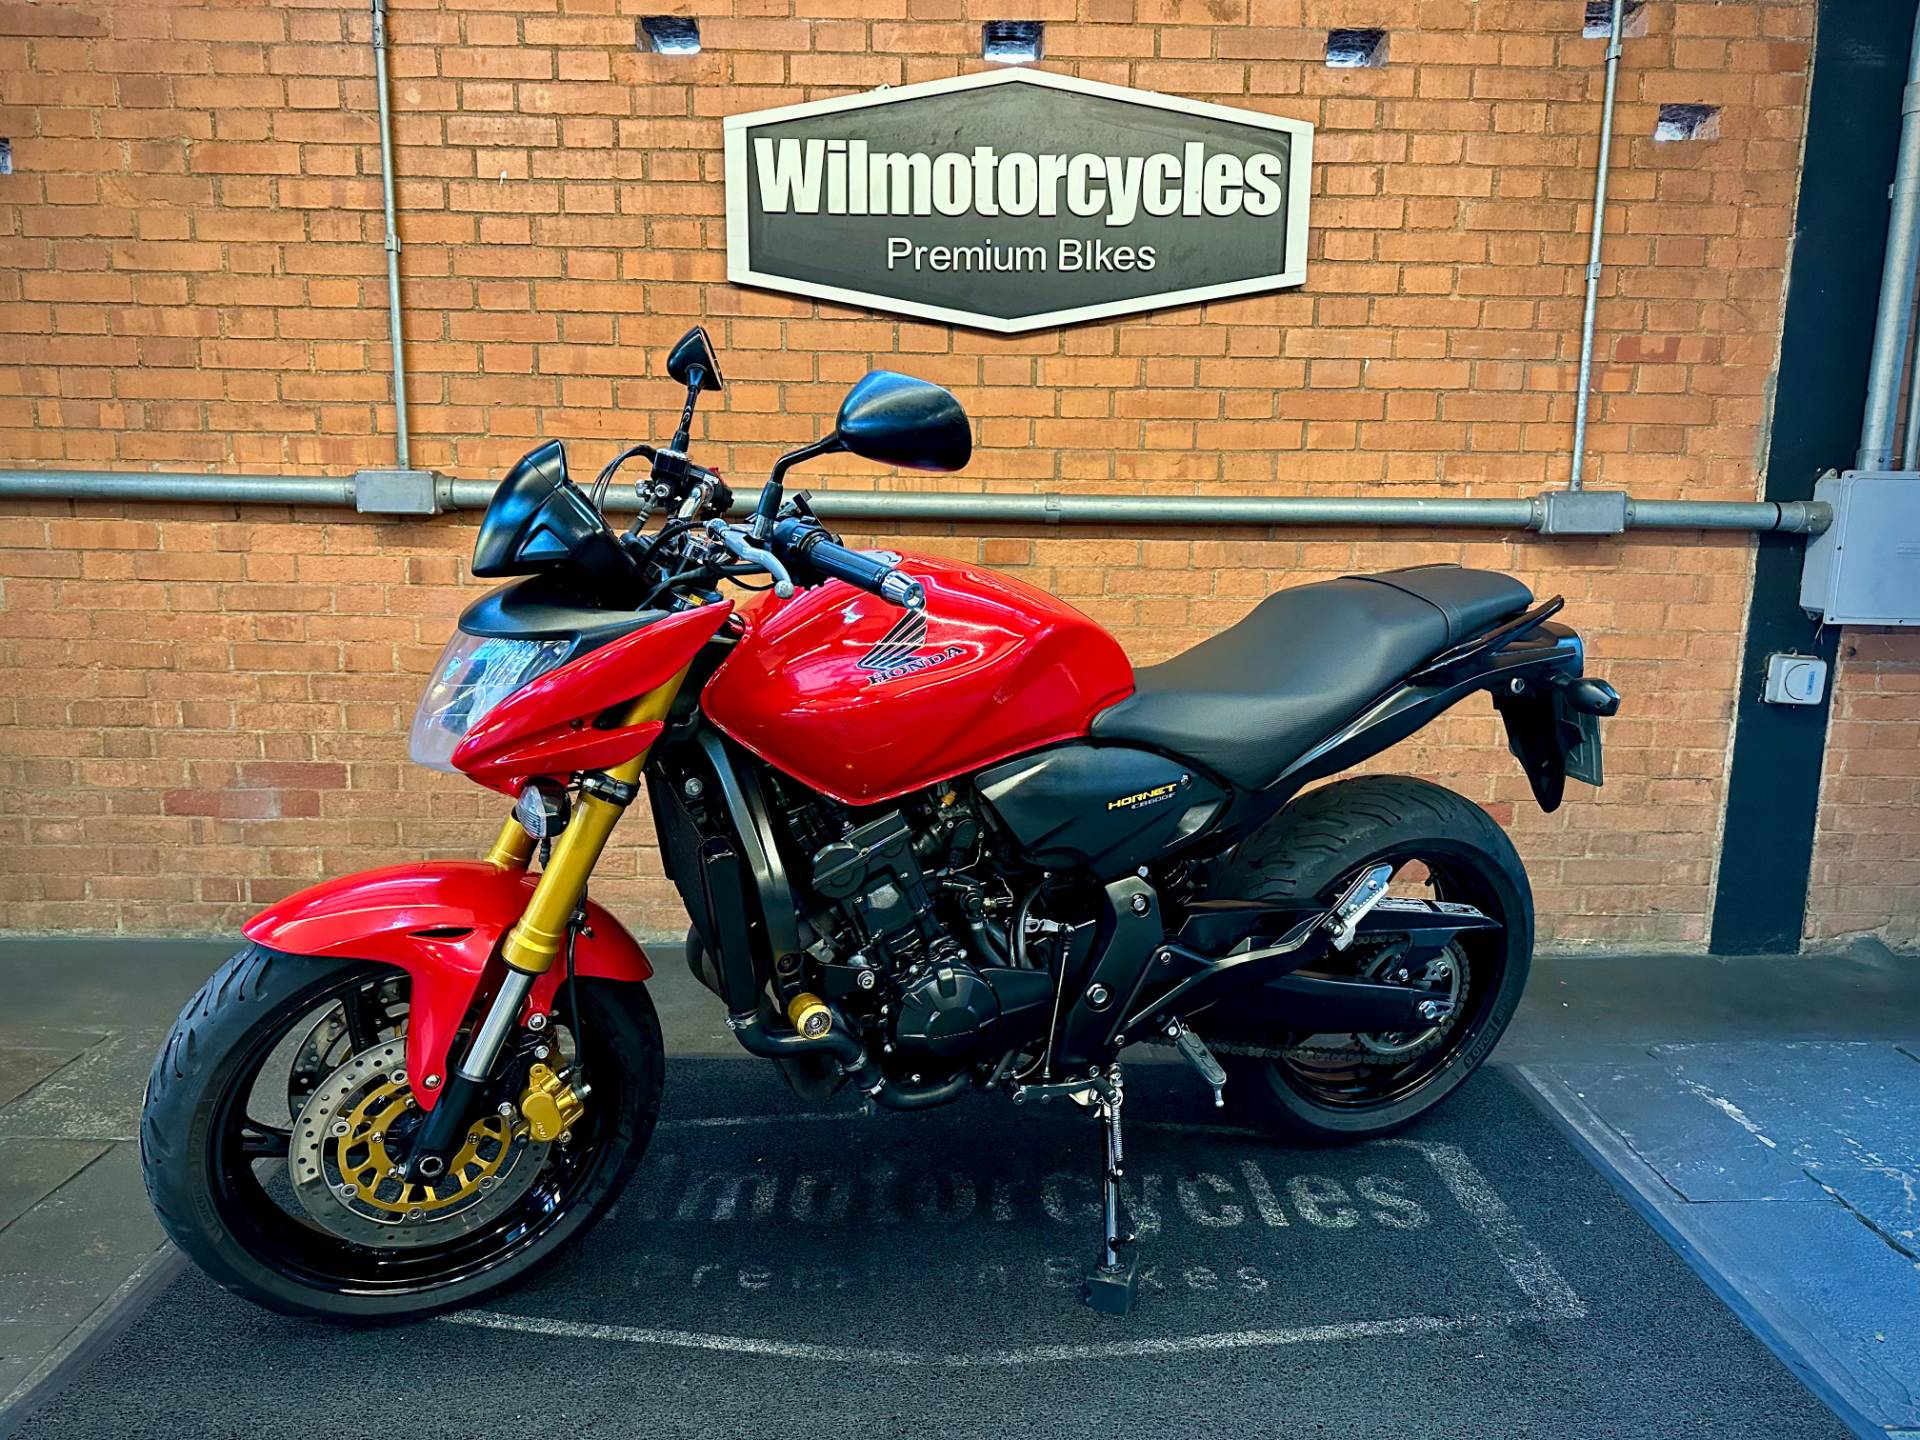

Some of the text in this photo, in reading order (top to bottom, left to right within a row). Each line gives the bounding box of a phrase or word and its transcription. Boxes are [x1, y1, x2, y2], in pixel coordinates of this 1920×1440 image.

[753, 137, 1283, 226] Wilmotorcycles
[886, 238, 1047, 271] Premium
[867, 645, 967, 685] HONDA
[1106, 783, 1178, 811] HORNET
